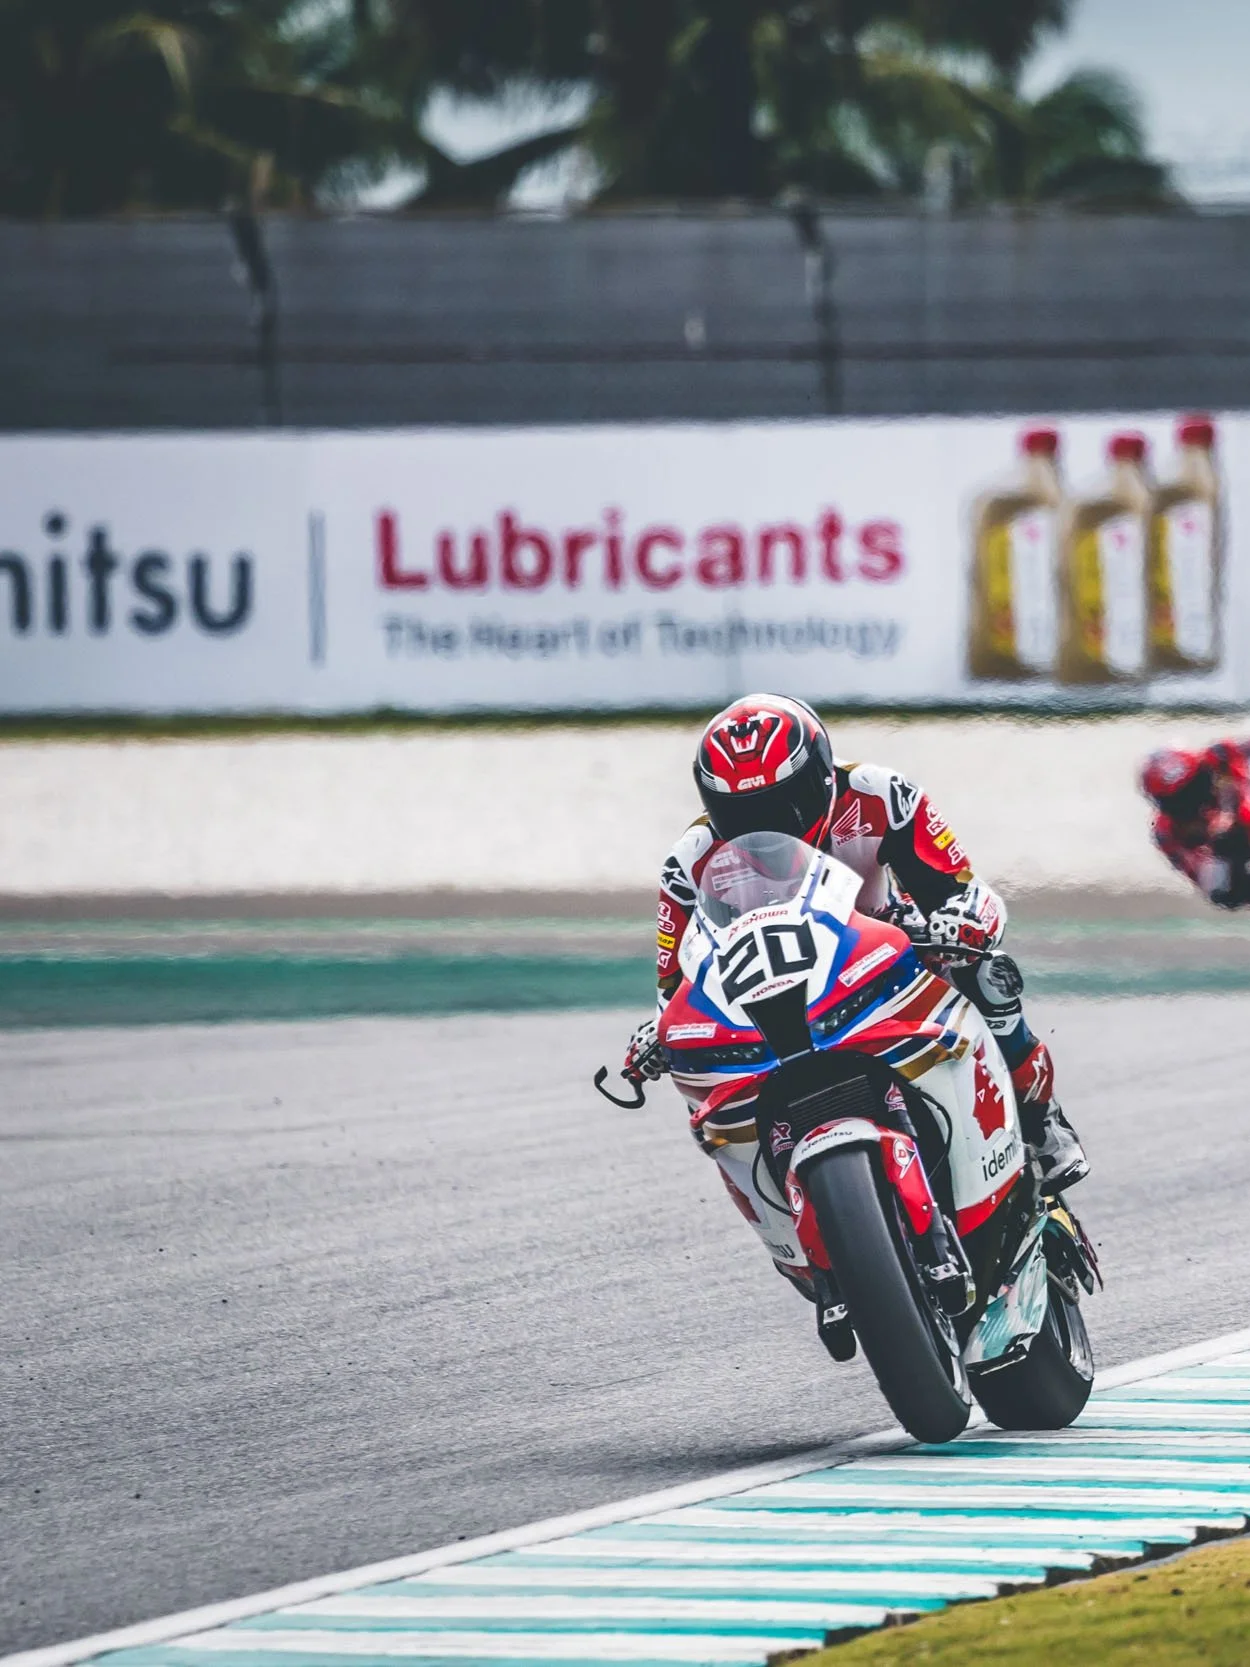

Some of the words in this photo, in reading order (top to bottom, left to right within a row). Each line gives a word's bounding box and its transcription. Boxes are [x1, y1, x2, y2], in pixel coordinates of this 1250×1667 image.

[374, 508, 906, 592] Lubricants
[383, 612, 460, 658] The
[737, 775, 766, 791] GIVI
[836, 825, 871, 846] HONDA
[743, 910, 789, 925] SHOWA
[717, 919, 818, 1006] 20
[751, 979, 796, 1000] HONDA
[801, 1131, 853, 1155] idemitsu
